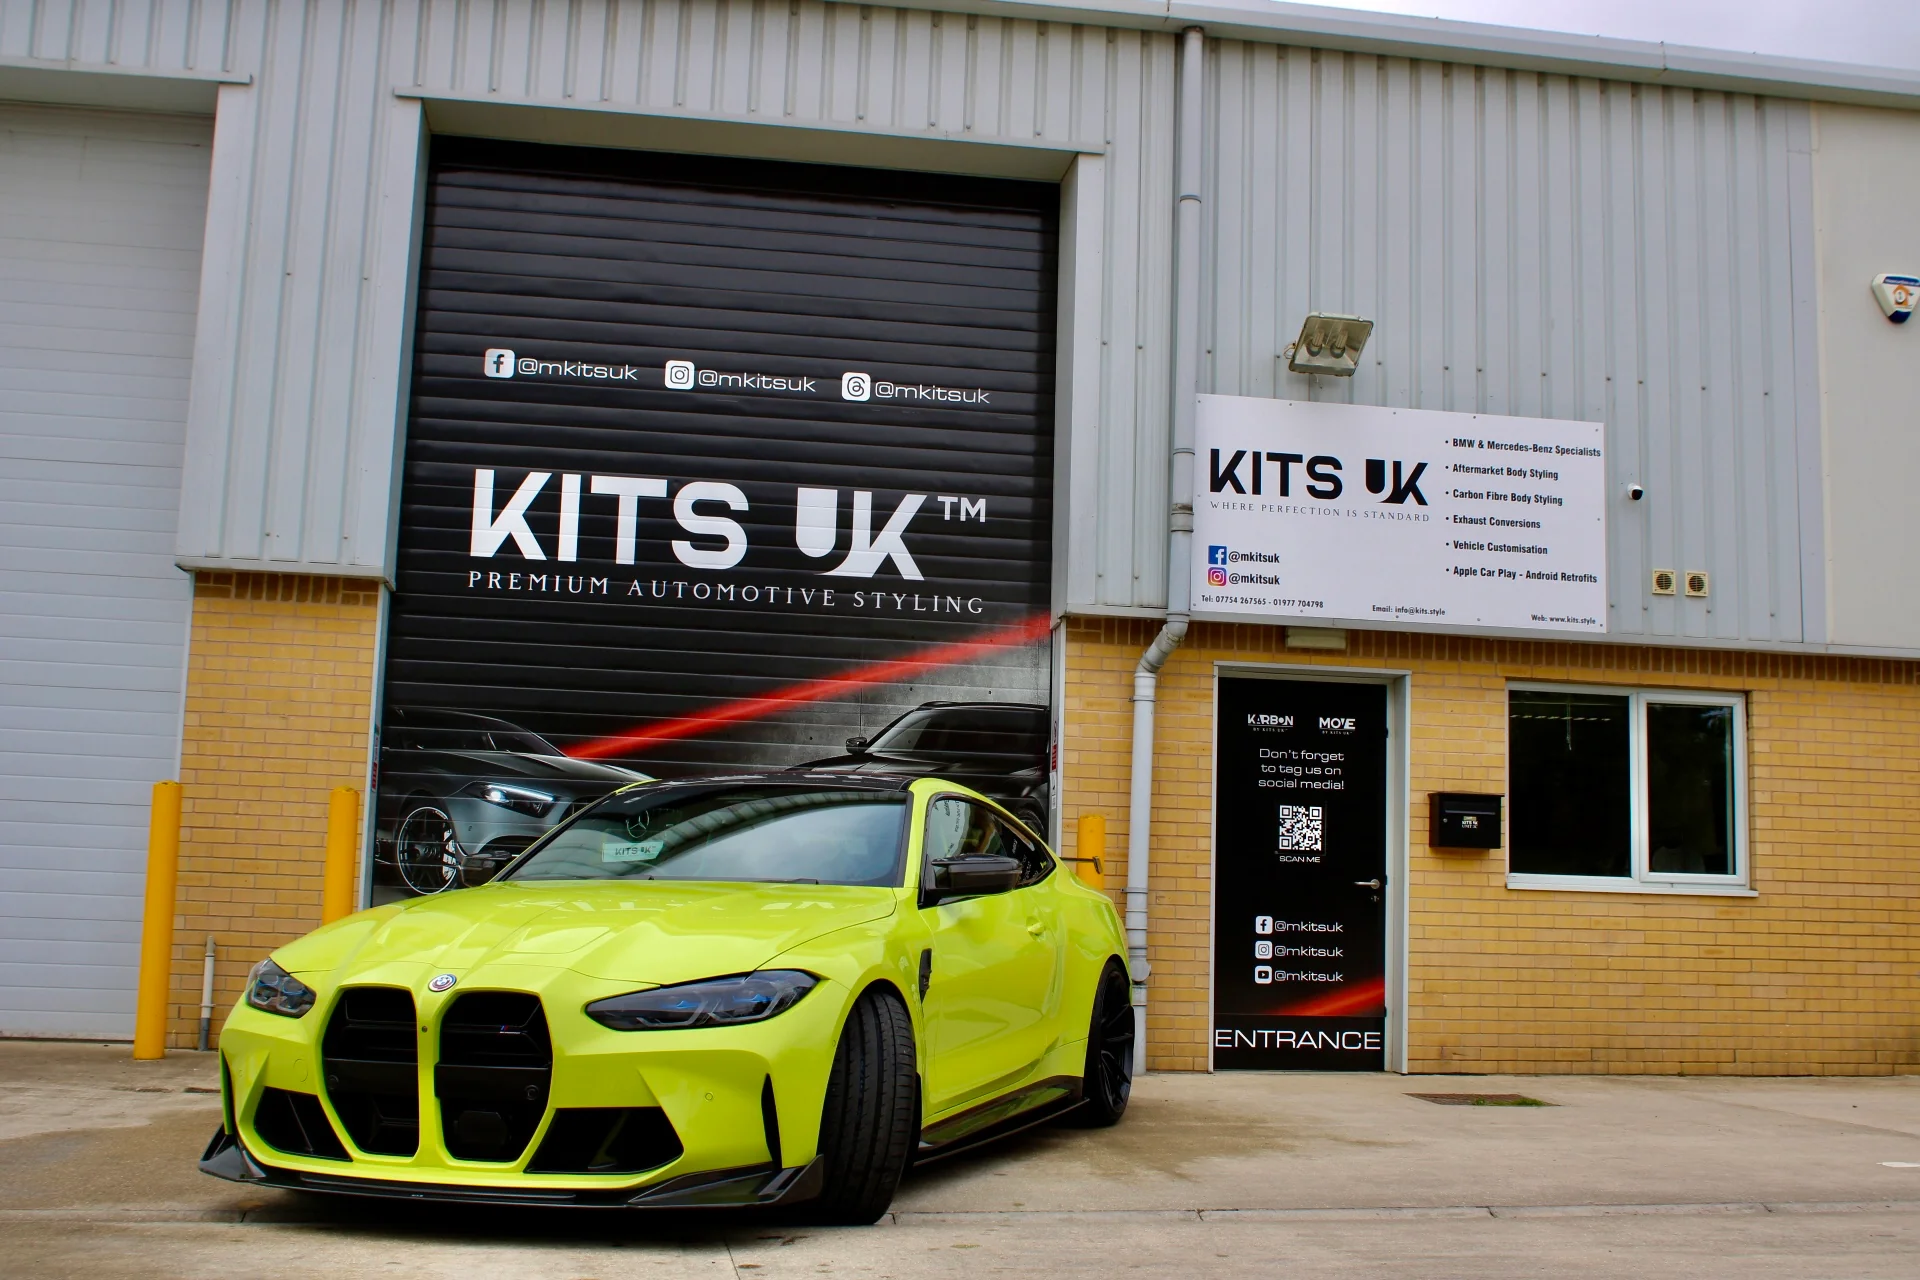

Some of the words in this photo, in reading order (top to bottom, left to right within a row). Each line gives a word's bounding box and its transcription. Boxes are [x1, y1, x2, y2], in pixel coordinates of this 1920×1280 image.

[518, 358, 637, 380] @mkitsuk
[699, 370, 816, 392] @mkitsuk
[875, 382, 989, 403] @mkitsuk
[1453, 438, 1475, 448] BMW
[1478, 440, 1484, 448] &
[1488, 441, 1552, 453] Mercedes-Benz
[1555, 445, 1600, 456] Specialists
[1210, 449, 1342, 499] KITS
[1366, 459, 1428, 506] UK
[1453, 464, 1503, 475] Aftermarket
[1507, 467, 1527, 478] Body
[1530, 469, 1558, 481] Styling
[1453, 489, 1483, 499] Carbon
[1487, 491, 1508, 501] Fibre
[1511, 493, 1531, 504] Body
[1534, 494, 1562, 506] Styling
[1211, 501, 1253, 510] WHERE
[1262, 505, 1339, 516] PERFECTION
[1364, 511, 1429, 521] STANDARD
[470, 469, 749, 570] KITS
[796, 487, 927, 580] UK
[1454, 515, 1486, 525] Exhaust
[1490, 517, 1540, 528] Conversions
[1453, 540, 1484, 550] Vehicle
[1488, 543, 1547, 554] Customisation
[1229, 551, 1279, 563] @mkitsuk
[1229, 573, 1279, 585] @mkitsuk
[1454, 566, 1477, 577] Apple
[1481, 568, 1495, 576] Car
[1498, 569, 1516, 580] Play
[1526, 571, 1558, 580] Android
[1561, 572, 1597, 583] Retrofits
[469, 571, 608, 594] PREMIUM
[627, 580, 834, 608] AUTOMOTIVE
[854, 592, 982, 613] STYLING
[1240, 597, 1266, 605] 267565
[1298, 600, 1323, 608] 704798
[1395, 606, 1446, 615] info@kits.style
[1550, 616, 1595, 625] www.kits.style
[1248, 714, 1293, 724] KARBON
[1319, 717, 1355, 729] MOVE
[1260, 749, 1298, 759] Don't
[1301, 750, 1344, 762] forget
[1279, 765, 1302, 776] tag
[1258, 779, 1297, 788] social
[1301, 780, 1344, 789] media!
[615, 847, 637, 855] KITS
[1275, 921, 1343, 932] @mkitsuk
[1275, 946, 1343, 956] @mkitsuk
[1275, 971, 1343, 981] @mkitsuk
[1216, 1030, 1380, 1049] ENTRANCE
